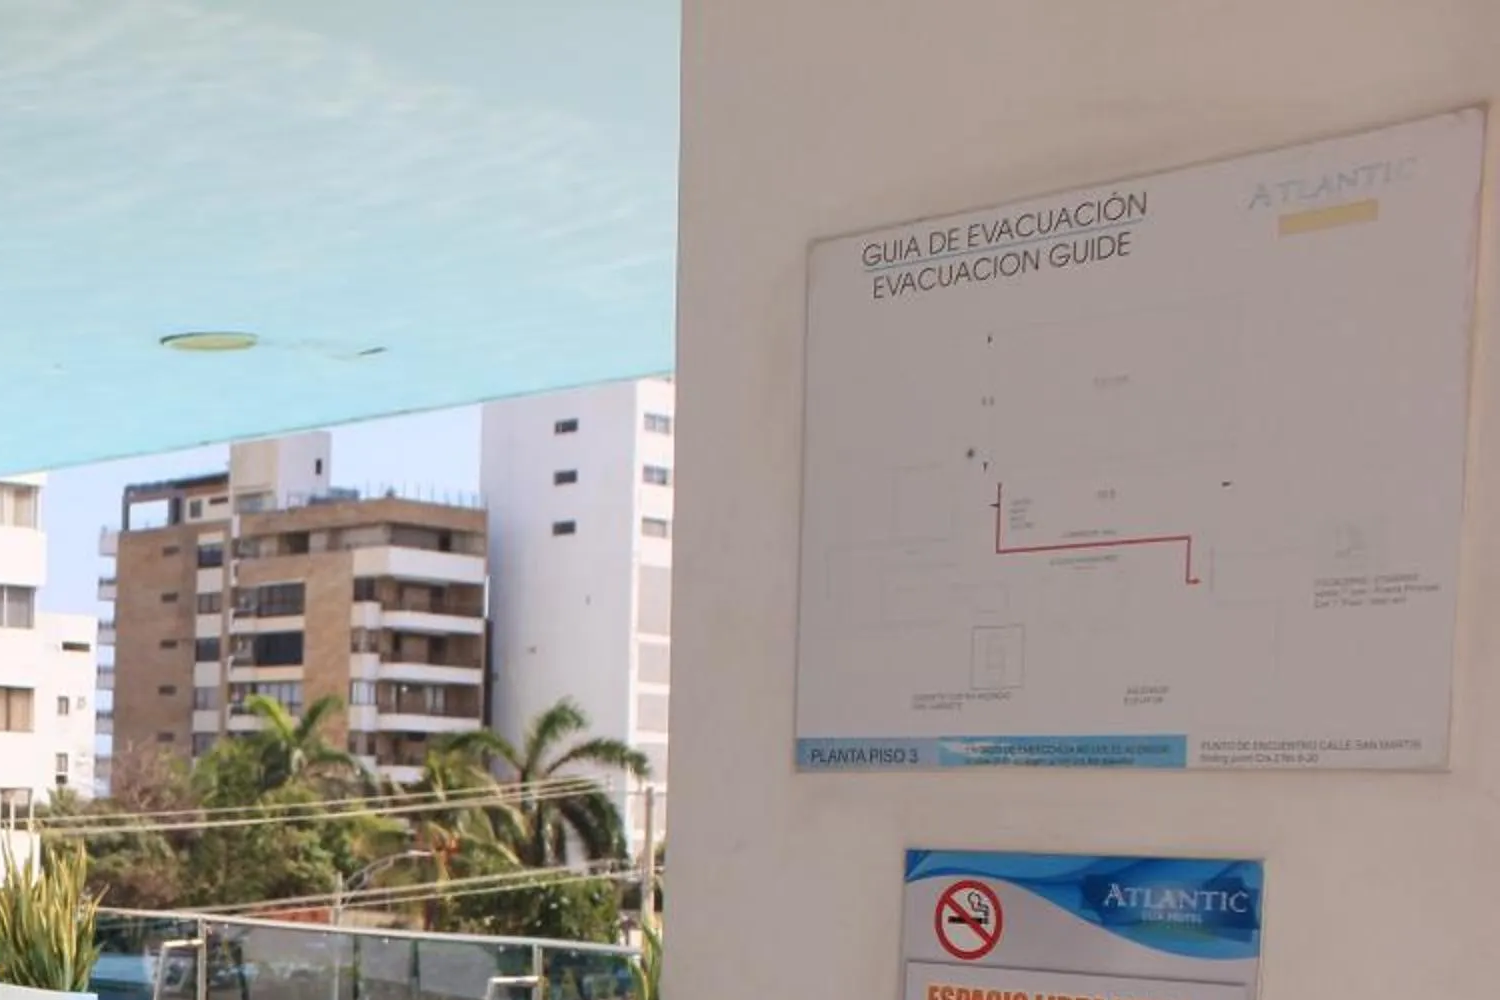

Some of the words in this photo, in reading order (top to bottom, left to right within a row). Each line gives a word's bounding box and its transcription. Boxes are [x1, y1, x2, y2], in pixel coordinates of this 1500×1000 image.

[862, 236, 921, 266] GUIA
[929, 228, 961, 256] DE
[967, 191, 1148, 247] EVACUACIÓN
[873, 249, 1040, 299] EVACUACION
[1050, 231, 1132, 268] GUIDE
[811, 748, 867, 764] PLANTA
[869, 748, 906, 763] PISO
[908, 748, 919, 763] 3
[1104, 882, 1249, 914] ATLANTIC
